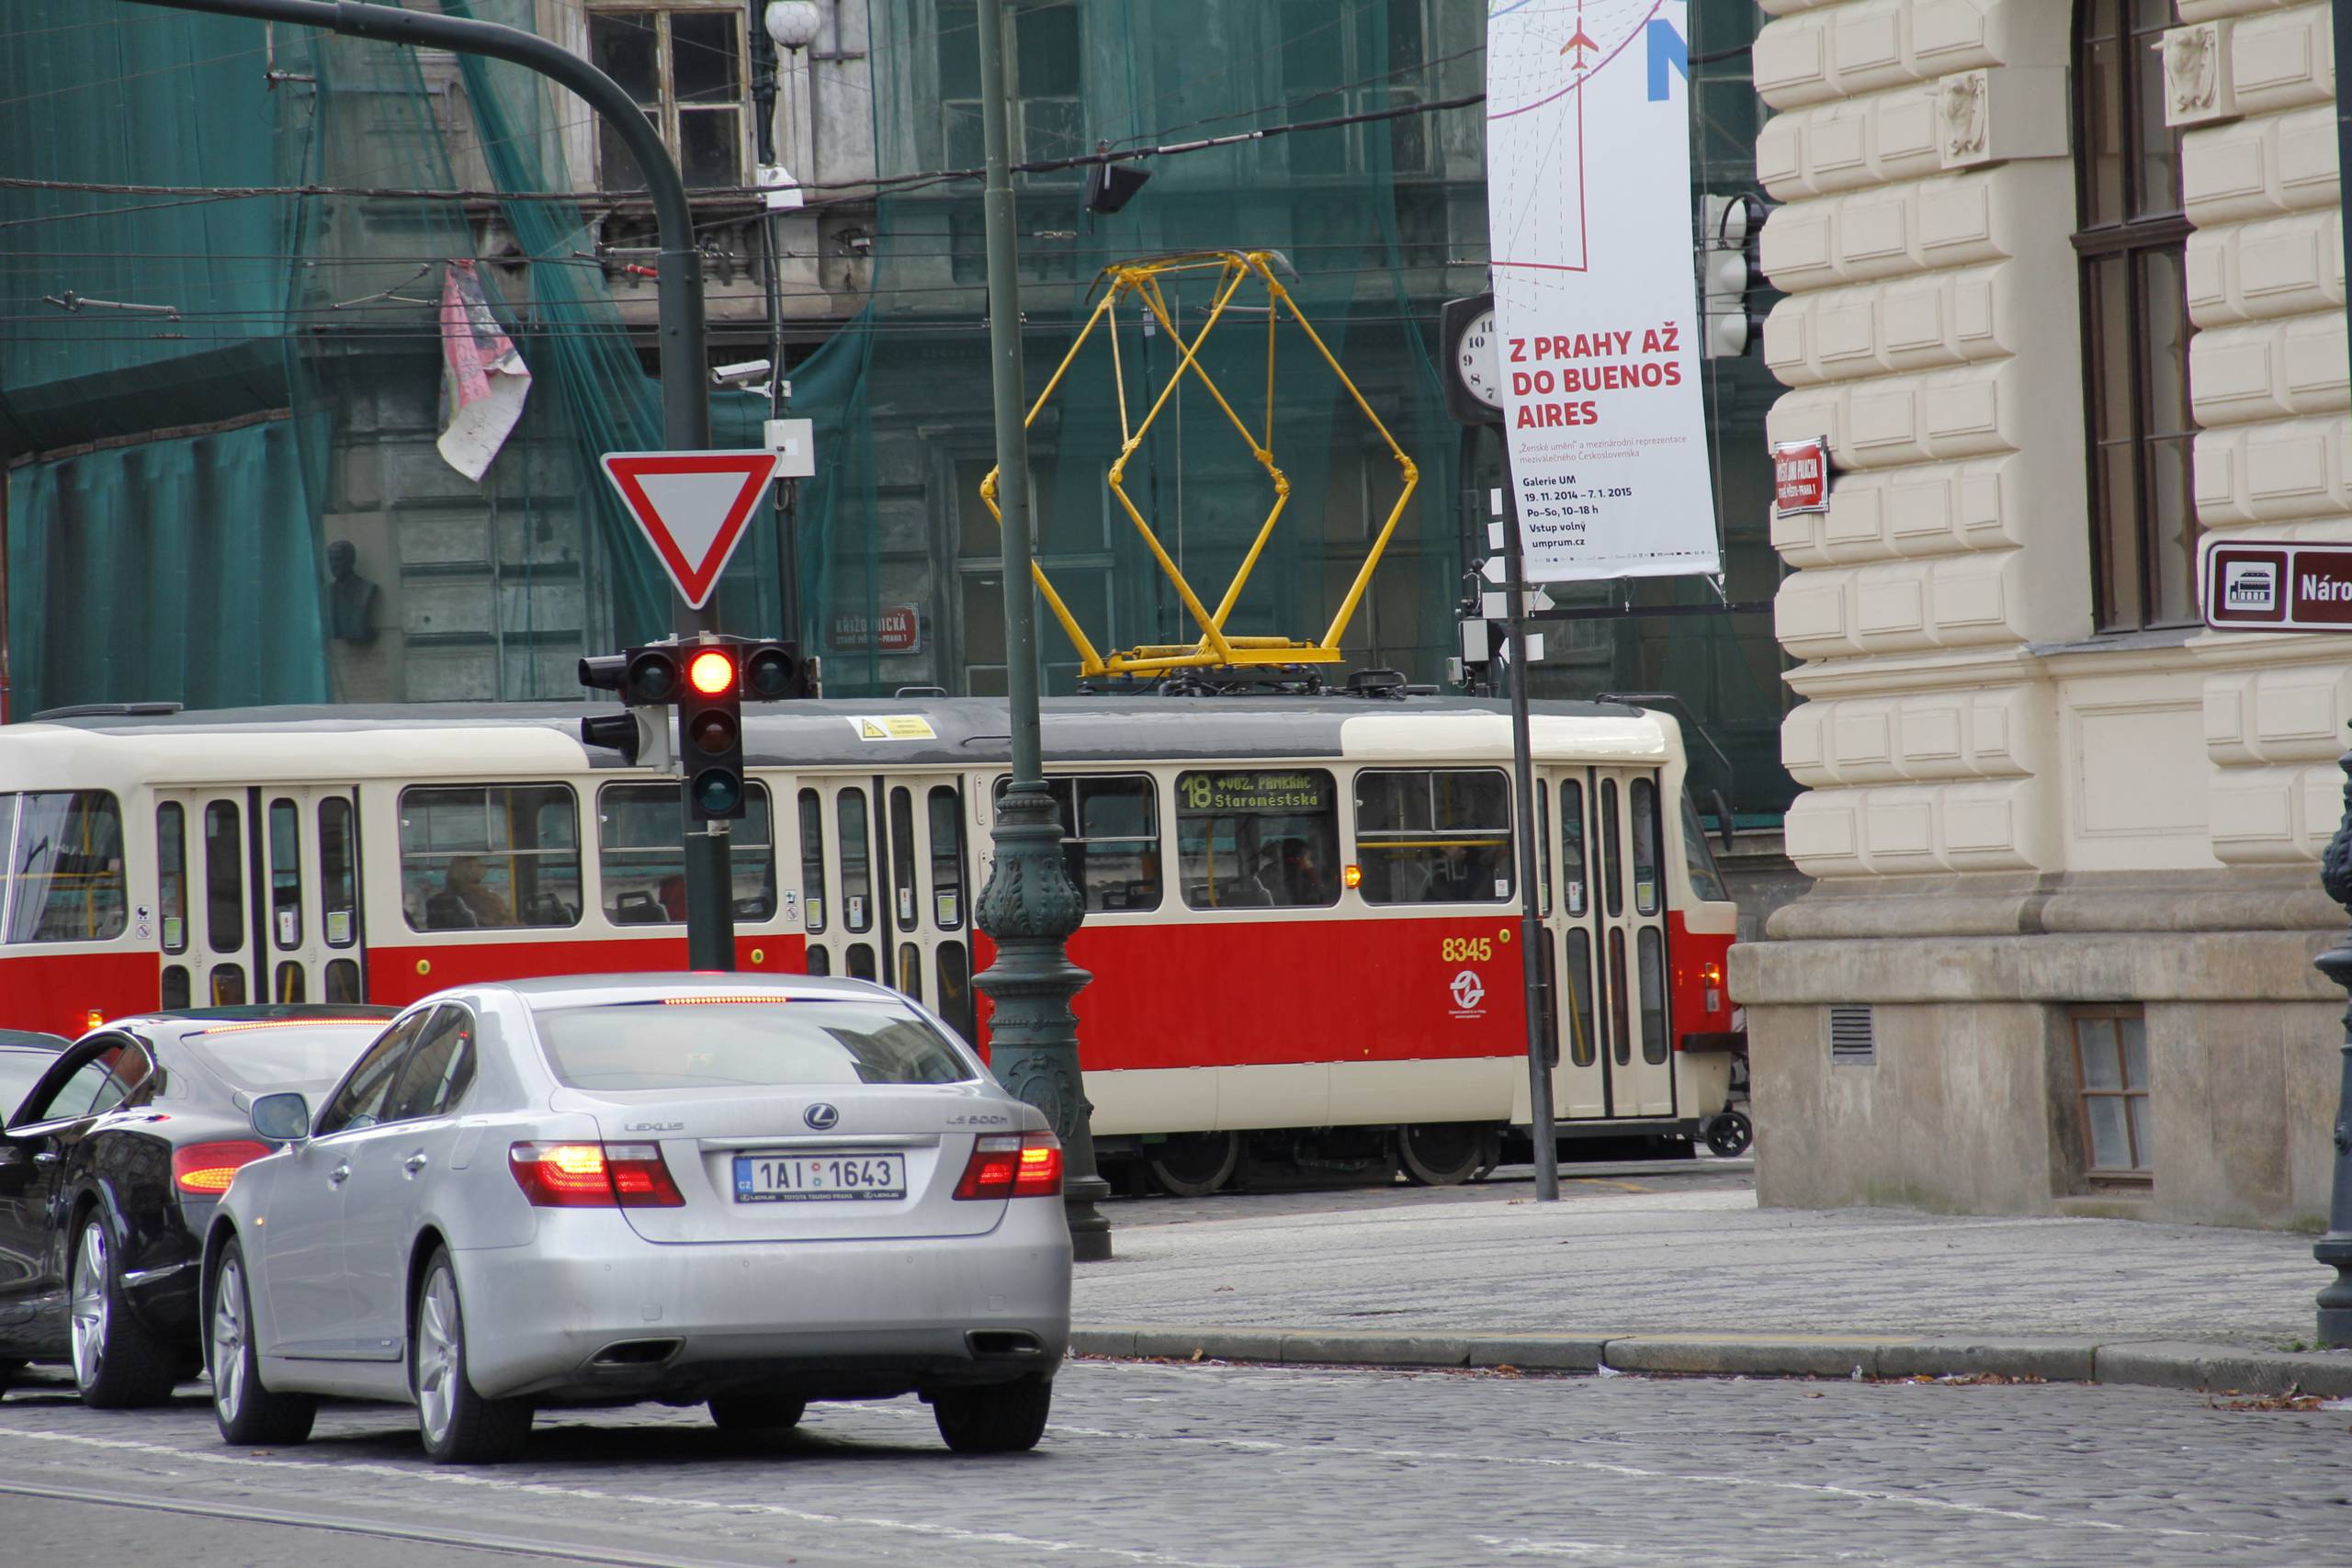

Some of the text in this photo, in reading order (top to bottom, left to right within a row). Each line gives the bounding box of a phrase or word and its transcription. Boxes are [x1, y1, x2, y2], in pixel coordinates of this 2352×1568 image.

[1481, 320, 1493, 333] 11
[1469, 336, 1485, 348] 10
[1509, 321, 1680, 363] Z PRAHY AŽ
[1463, 354, 1473, 367] 9
[1470, 373, 1481, 385] 8
[1512, 362, 1681, 396] DO BUENOS
[1486, 387, 1495, 400] 7
[1517, 400, 1599, 429] AIRES
[1586, 437, 1634, 449] mezinárodní
[1635, 436, 1687, 447] reprezentace
[1578, 449, 1640, 461] Československa
[1522, 475, 1577, 487] Galerie UM
[1525, 493, 1539, 502] 19.
[1542, 492, 1553, 502] 11.
[1555, 491, 1578, 501] 2014
[1588, 490, 1597, 499] 7.
[1599, 489, 1606, 498] 1.
[1608, 487, 1633, 498] 2015
[1591, 505, 1600, 514] h
[1530, 522, 1587, 534] Vstup volný
[1532, 538, 1586, 549] umprum.cz
[2301, 573, 2352, 602] Náro
[1181, 774, 1212, 808] 18
[1215, 792, 1318, 807] Staroměstská
[1442, 937, 1492, 962] 8345
[946, 1115, 966, 1124] LS
[625, 1122, 684, 1132] LEXUS
[761, 1160, 891, 1189] 1AI 1643
[739, 1181, 752, 1190] CZ
